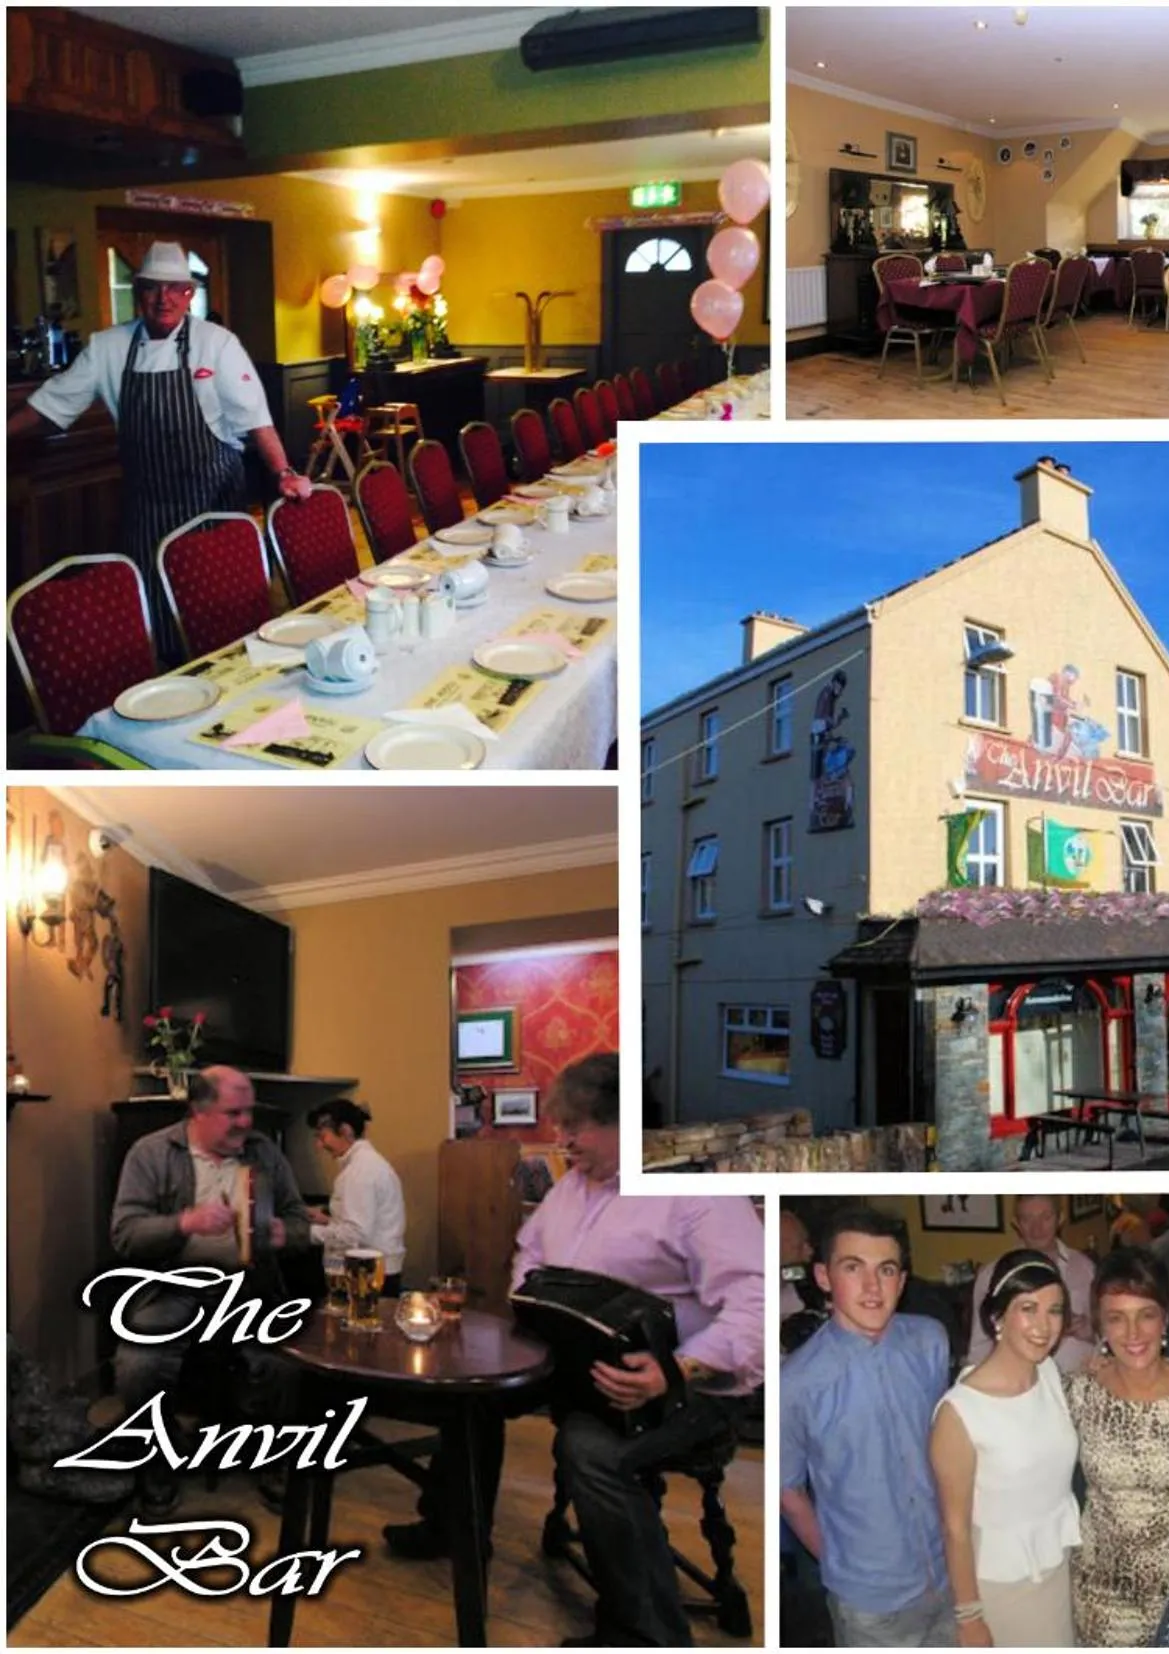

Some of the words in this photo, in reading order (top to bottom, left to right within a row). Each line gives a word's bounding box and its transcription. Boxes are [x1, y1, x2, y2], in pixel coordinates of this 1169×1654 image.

[986, 739, 1019, 767] The
[998, 748, 1093, 799] Anvil
[1095, 765, 1156, 807] Bar
